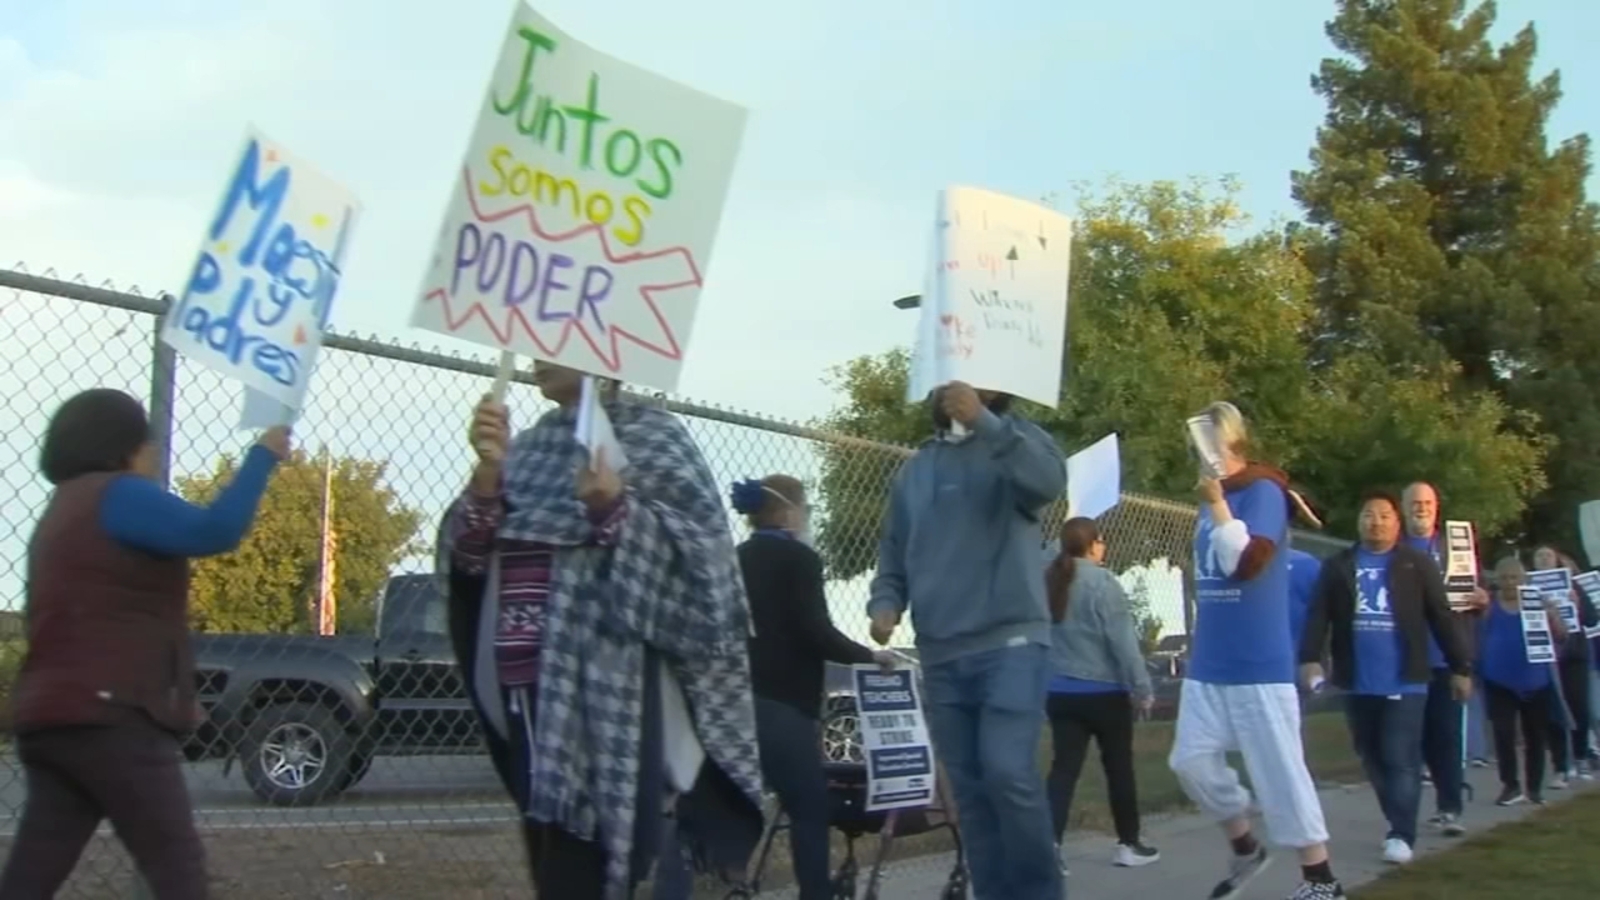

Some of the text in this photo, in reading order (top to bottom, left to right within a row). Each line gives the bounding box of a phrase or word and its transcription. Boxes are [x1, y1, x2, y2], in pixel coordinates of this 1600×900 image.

[492, 26, 683, 199] Juntos
[451, 222, 614, 334] PODER
[862, 690, 911, 704] TEACHERS
